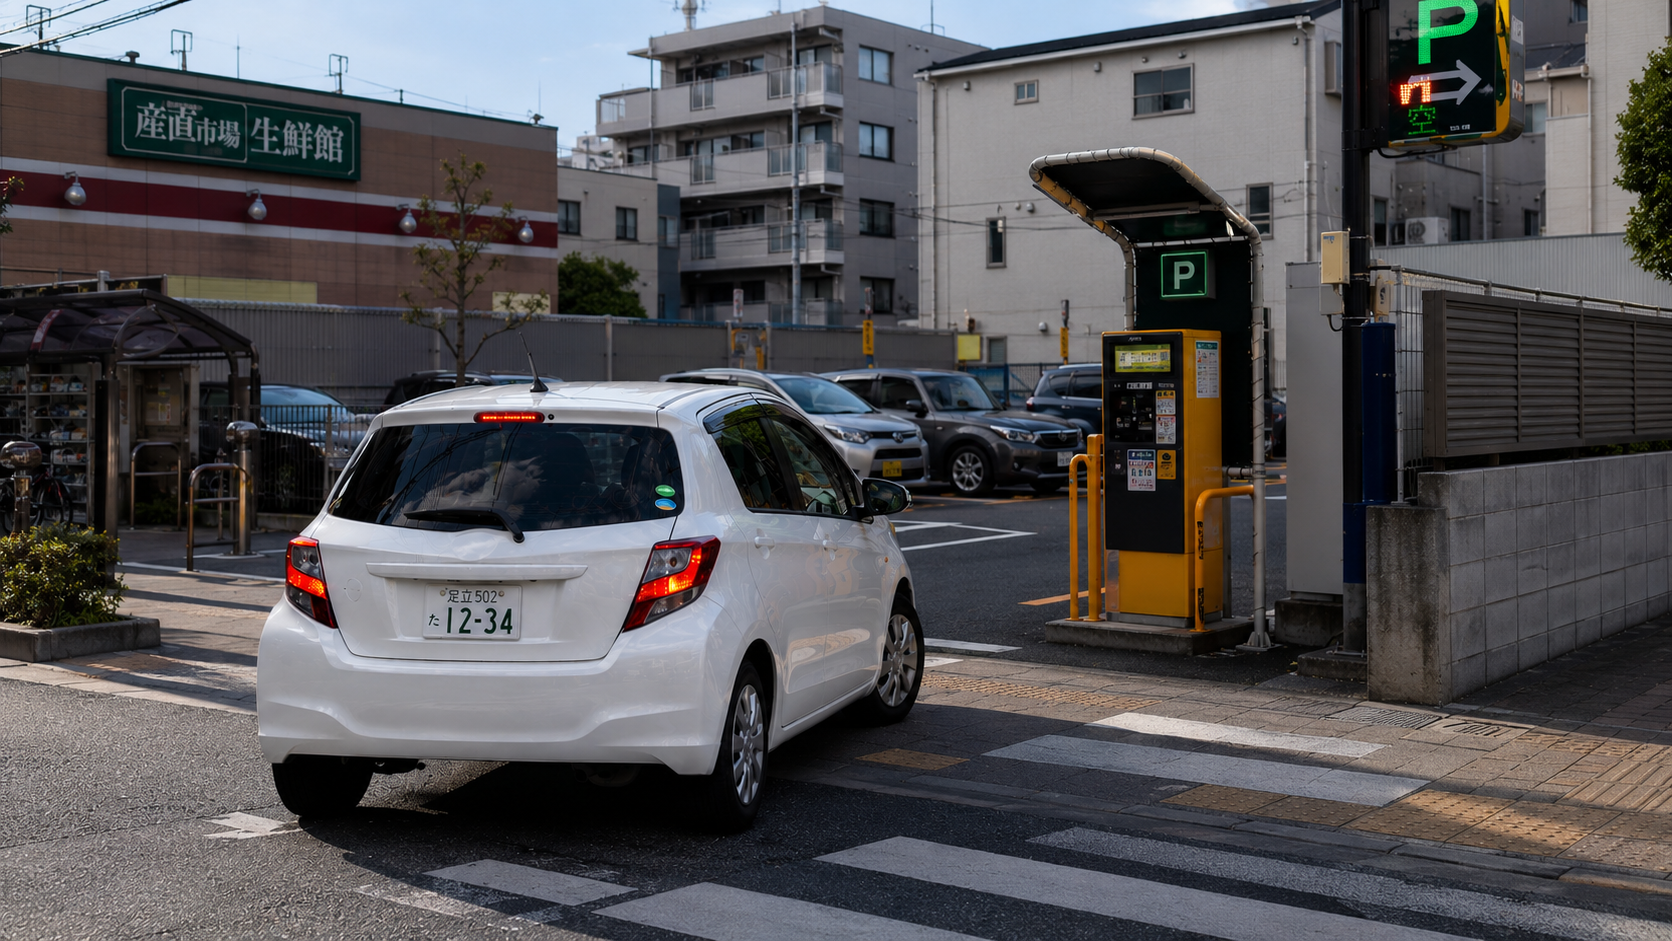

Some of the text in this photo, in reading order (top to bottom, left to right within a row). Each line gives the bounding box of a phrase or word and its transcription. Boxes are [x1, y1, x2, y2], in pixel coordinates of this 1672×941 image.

[1418, 0, 1479, 65] P
[135, 102, 344, 163] 産直市場 生鮮館
[1174, 260, 1195, 290] P
[428, 607, 513, 635] た 12-34
